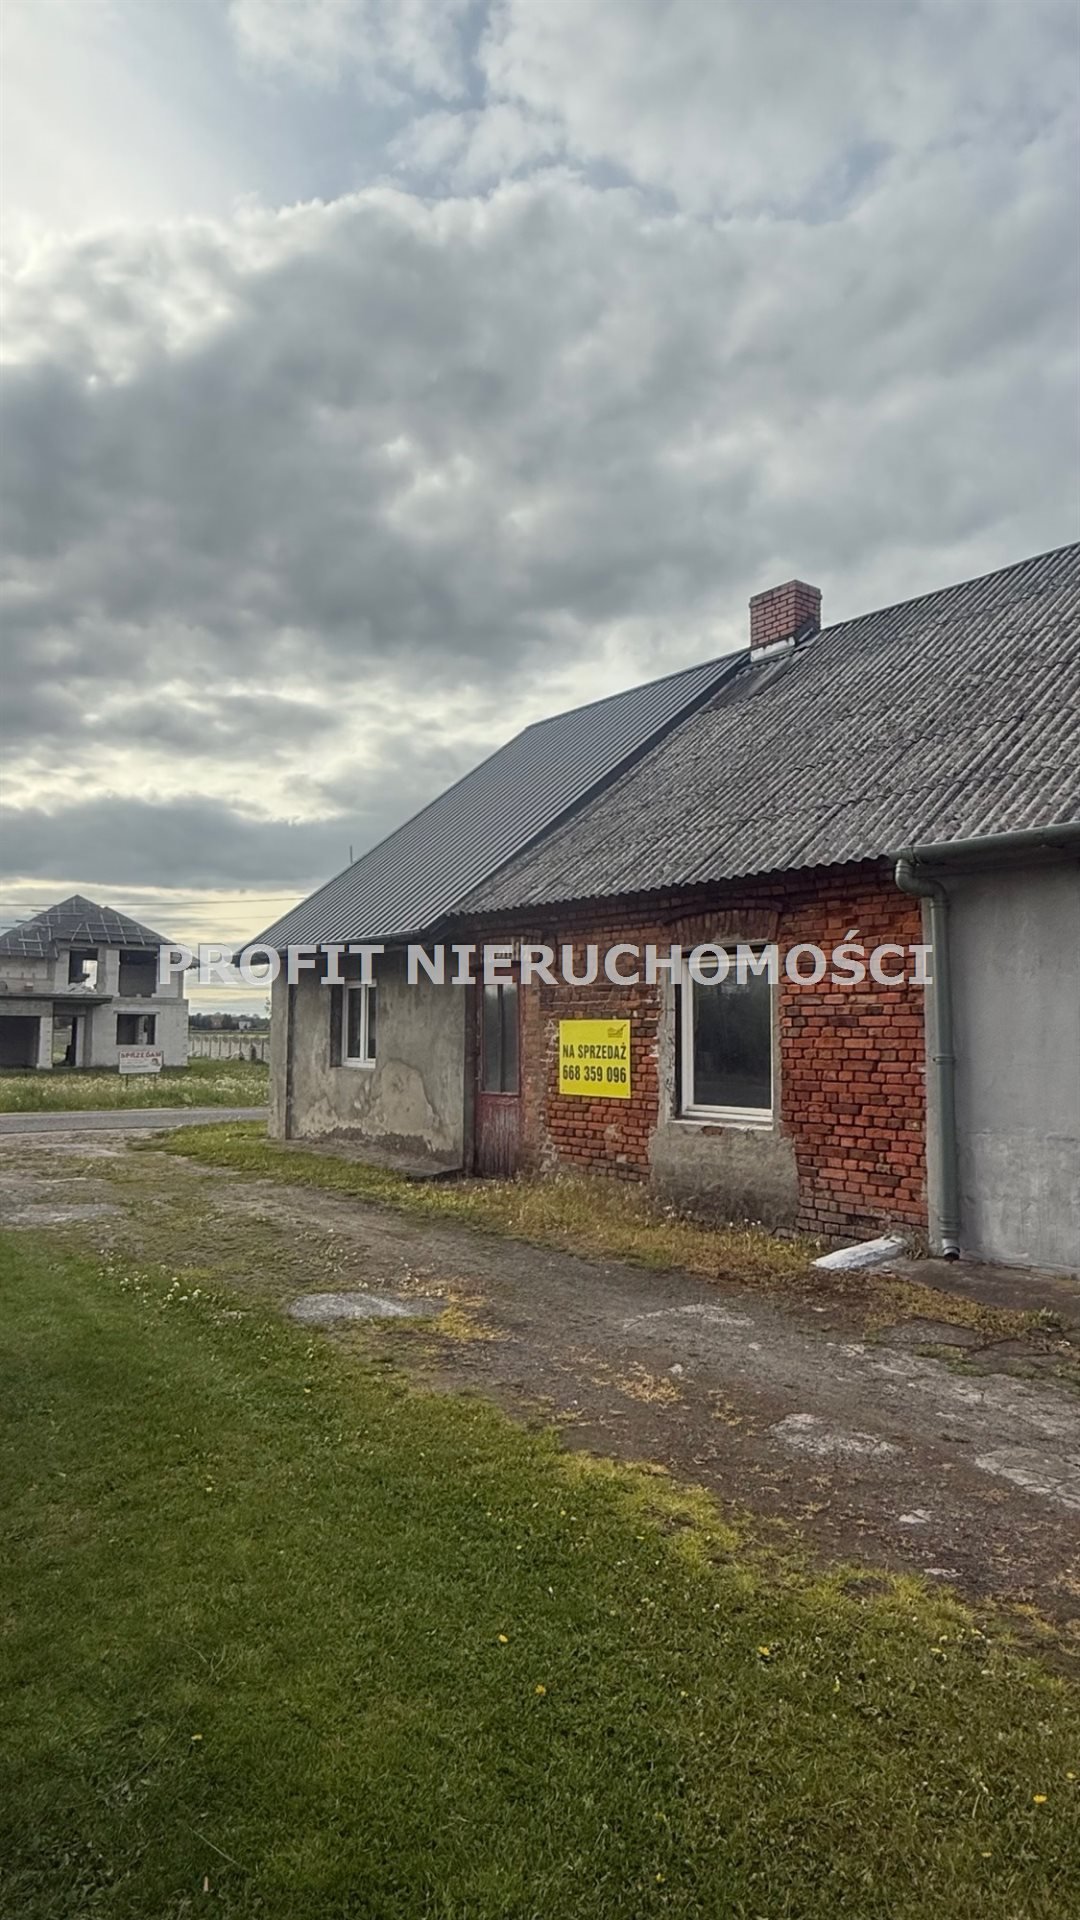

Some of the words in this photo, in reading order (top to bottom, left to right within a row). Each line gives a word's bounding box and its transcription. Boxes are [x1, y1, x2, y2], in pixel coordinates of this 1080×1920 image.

[562, 1044, 575, 1058] NA
[578, 1042, 626, 1060] SPRZEDAŻ
[562, 1065, 580, 1080] 668
[584, 1065, 603, 1082] 359
[606, 1066, 626, 1083] 096
